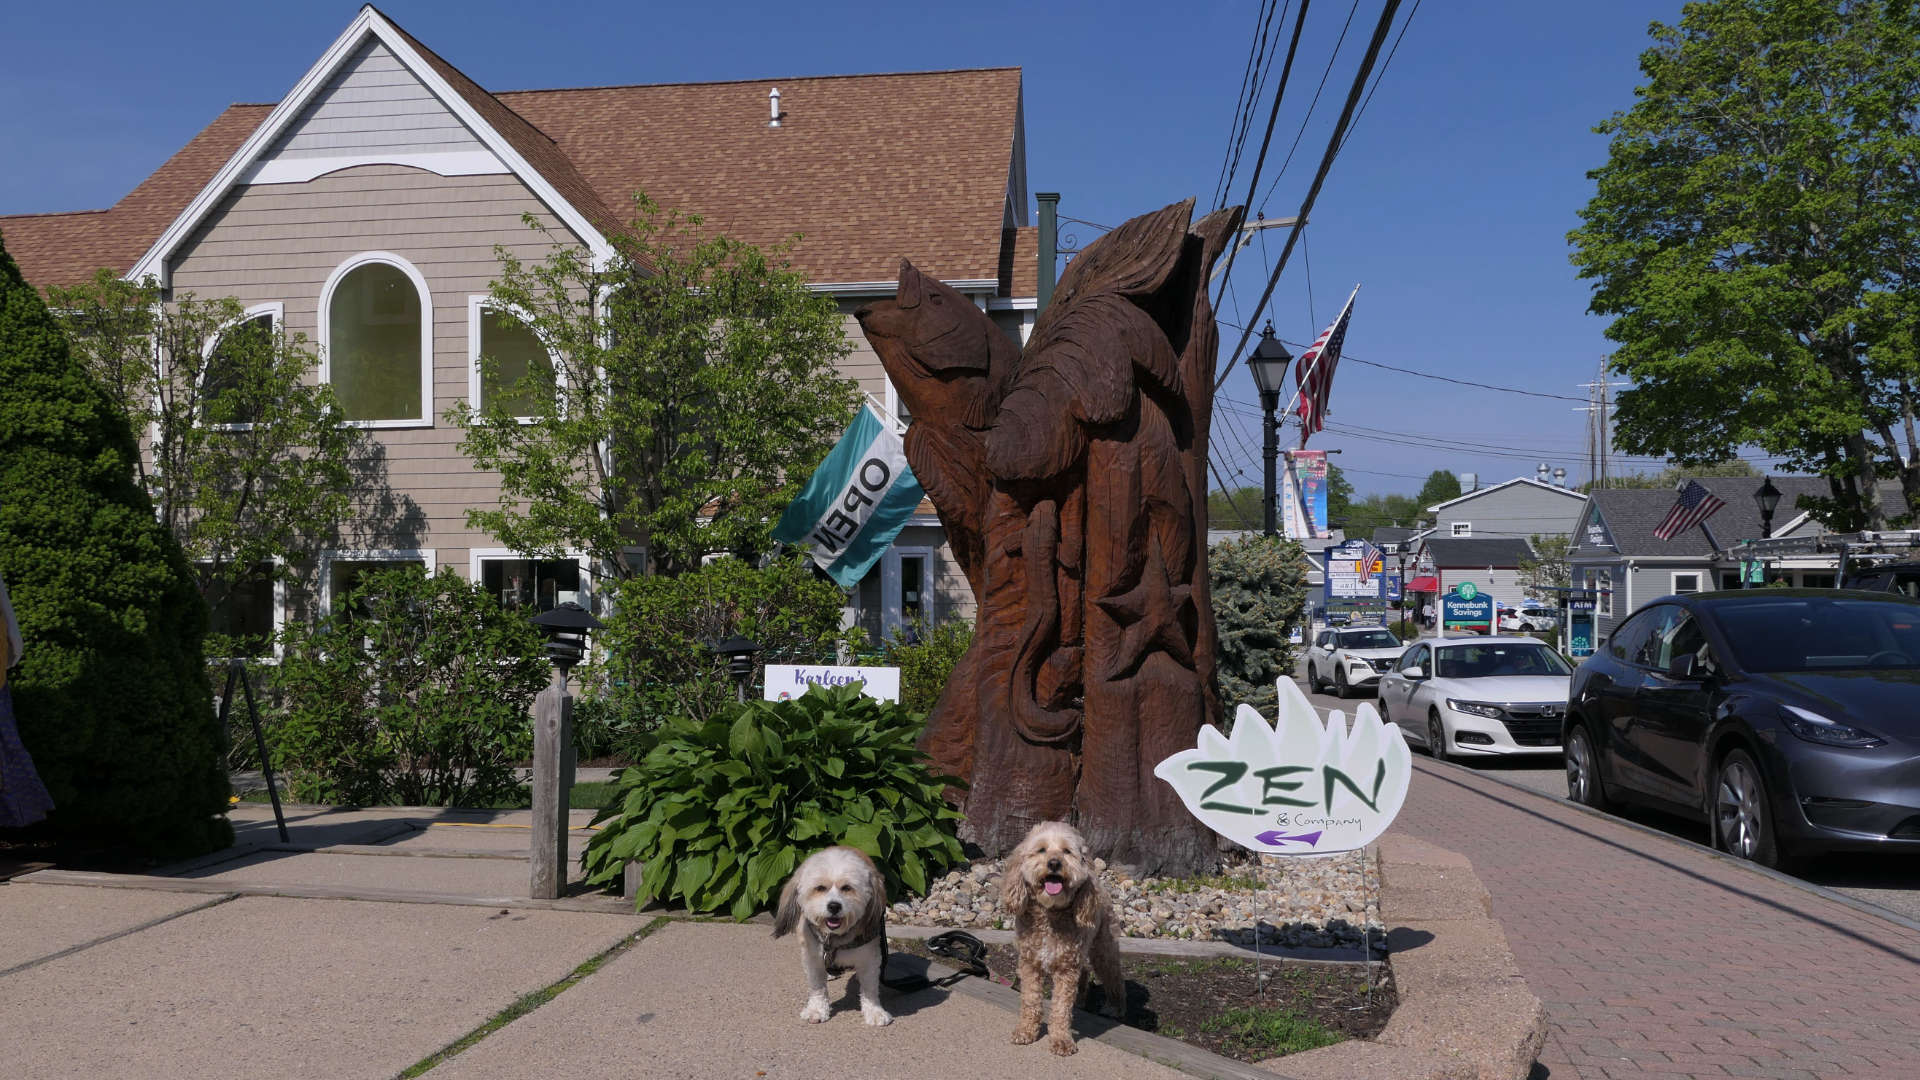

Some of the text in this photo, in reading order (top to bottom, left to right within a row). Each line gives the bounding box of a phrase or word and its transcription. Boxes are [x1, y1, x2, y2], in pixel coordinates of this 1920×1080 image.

[1447, 601, 1488, 609] Kennebunk
[1573, 601, 1593, 609] ATM
[1453, 608, 1483, 617] Savings
[794, 669, 868, 686] Karleen's
[1187, 757, 1386, 816] ZEN
[1277, 813, 1363, 831] & Company
